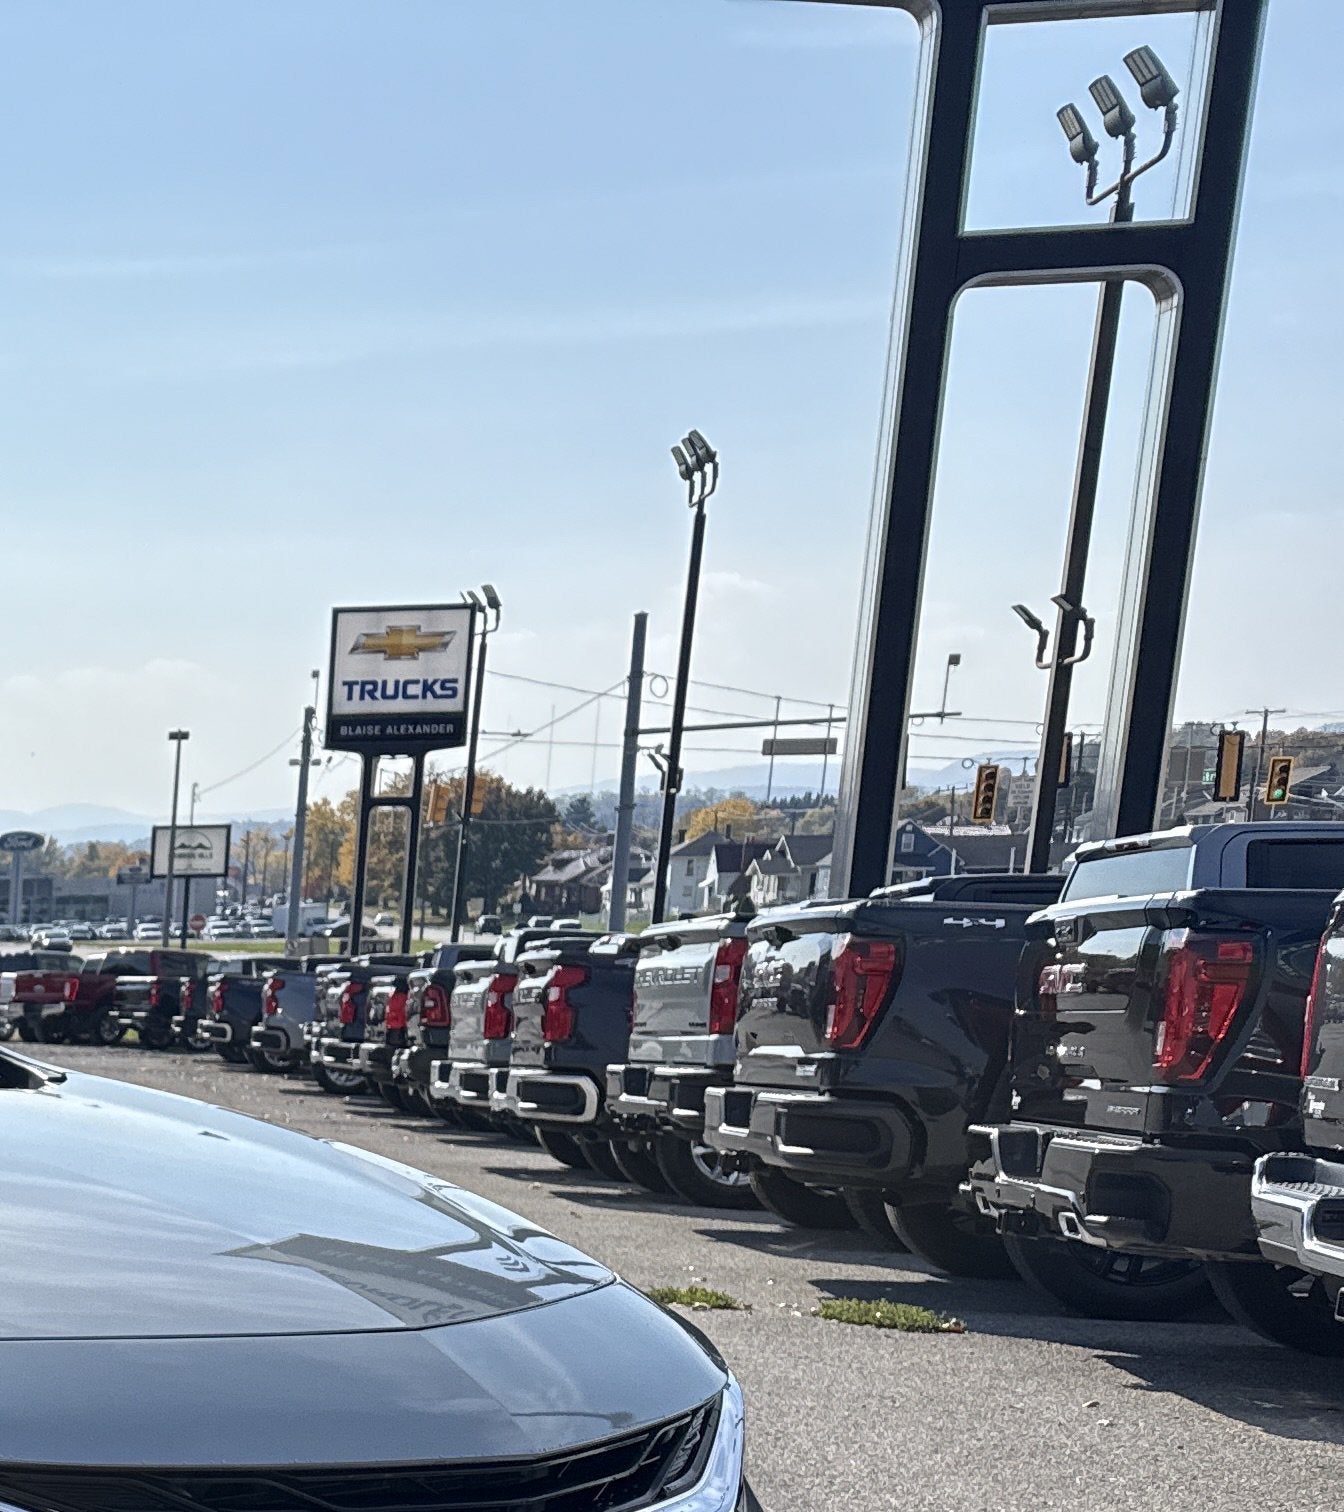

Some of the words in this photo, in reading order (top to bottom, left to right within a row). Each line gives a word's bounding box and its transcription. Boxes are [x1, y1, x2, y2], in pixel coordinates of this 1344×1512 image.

[341, 677, 459, 701] TRUCKS
[339, 724, 382, 736] BLAISE
[385, 723, 454, 735] ALEXANDER
